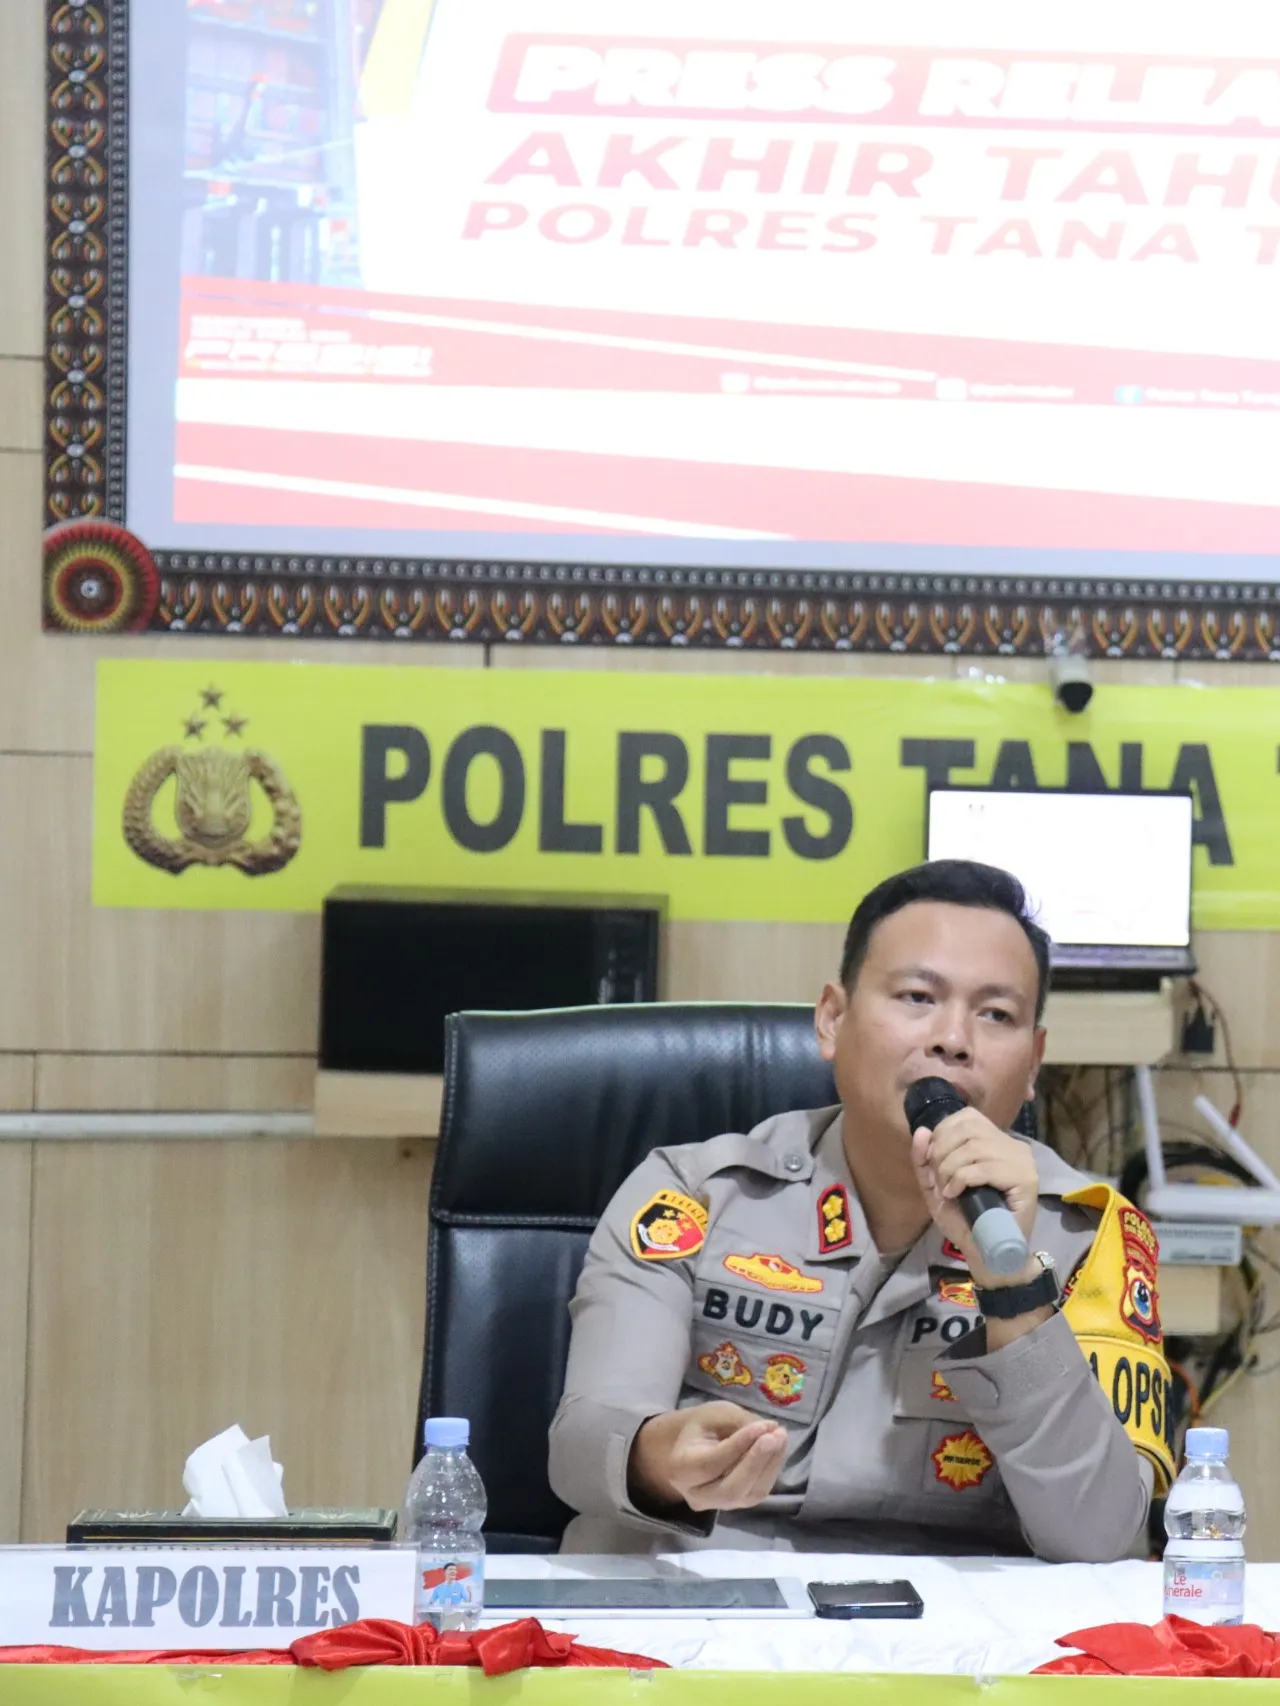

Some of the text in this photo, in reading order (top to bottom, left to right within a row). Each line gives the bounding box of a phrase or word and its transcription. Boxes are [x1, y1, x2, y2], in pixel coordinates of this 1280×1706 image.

[514, 44, 897, 115] PRESS
[484, 130, 934, 199] AKHIR
[460, 203, 880, 254] POLRES
[920, 214, 1200, 264] TANA
[359, 725, 854, 860] POLRES
[702, 1288, 824, 1341] BUDY
[48, 1564, 361, 1629] KAPOLRES
[1174, 1572, 1187, 1585] Le
